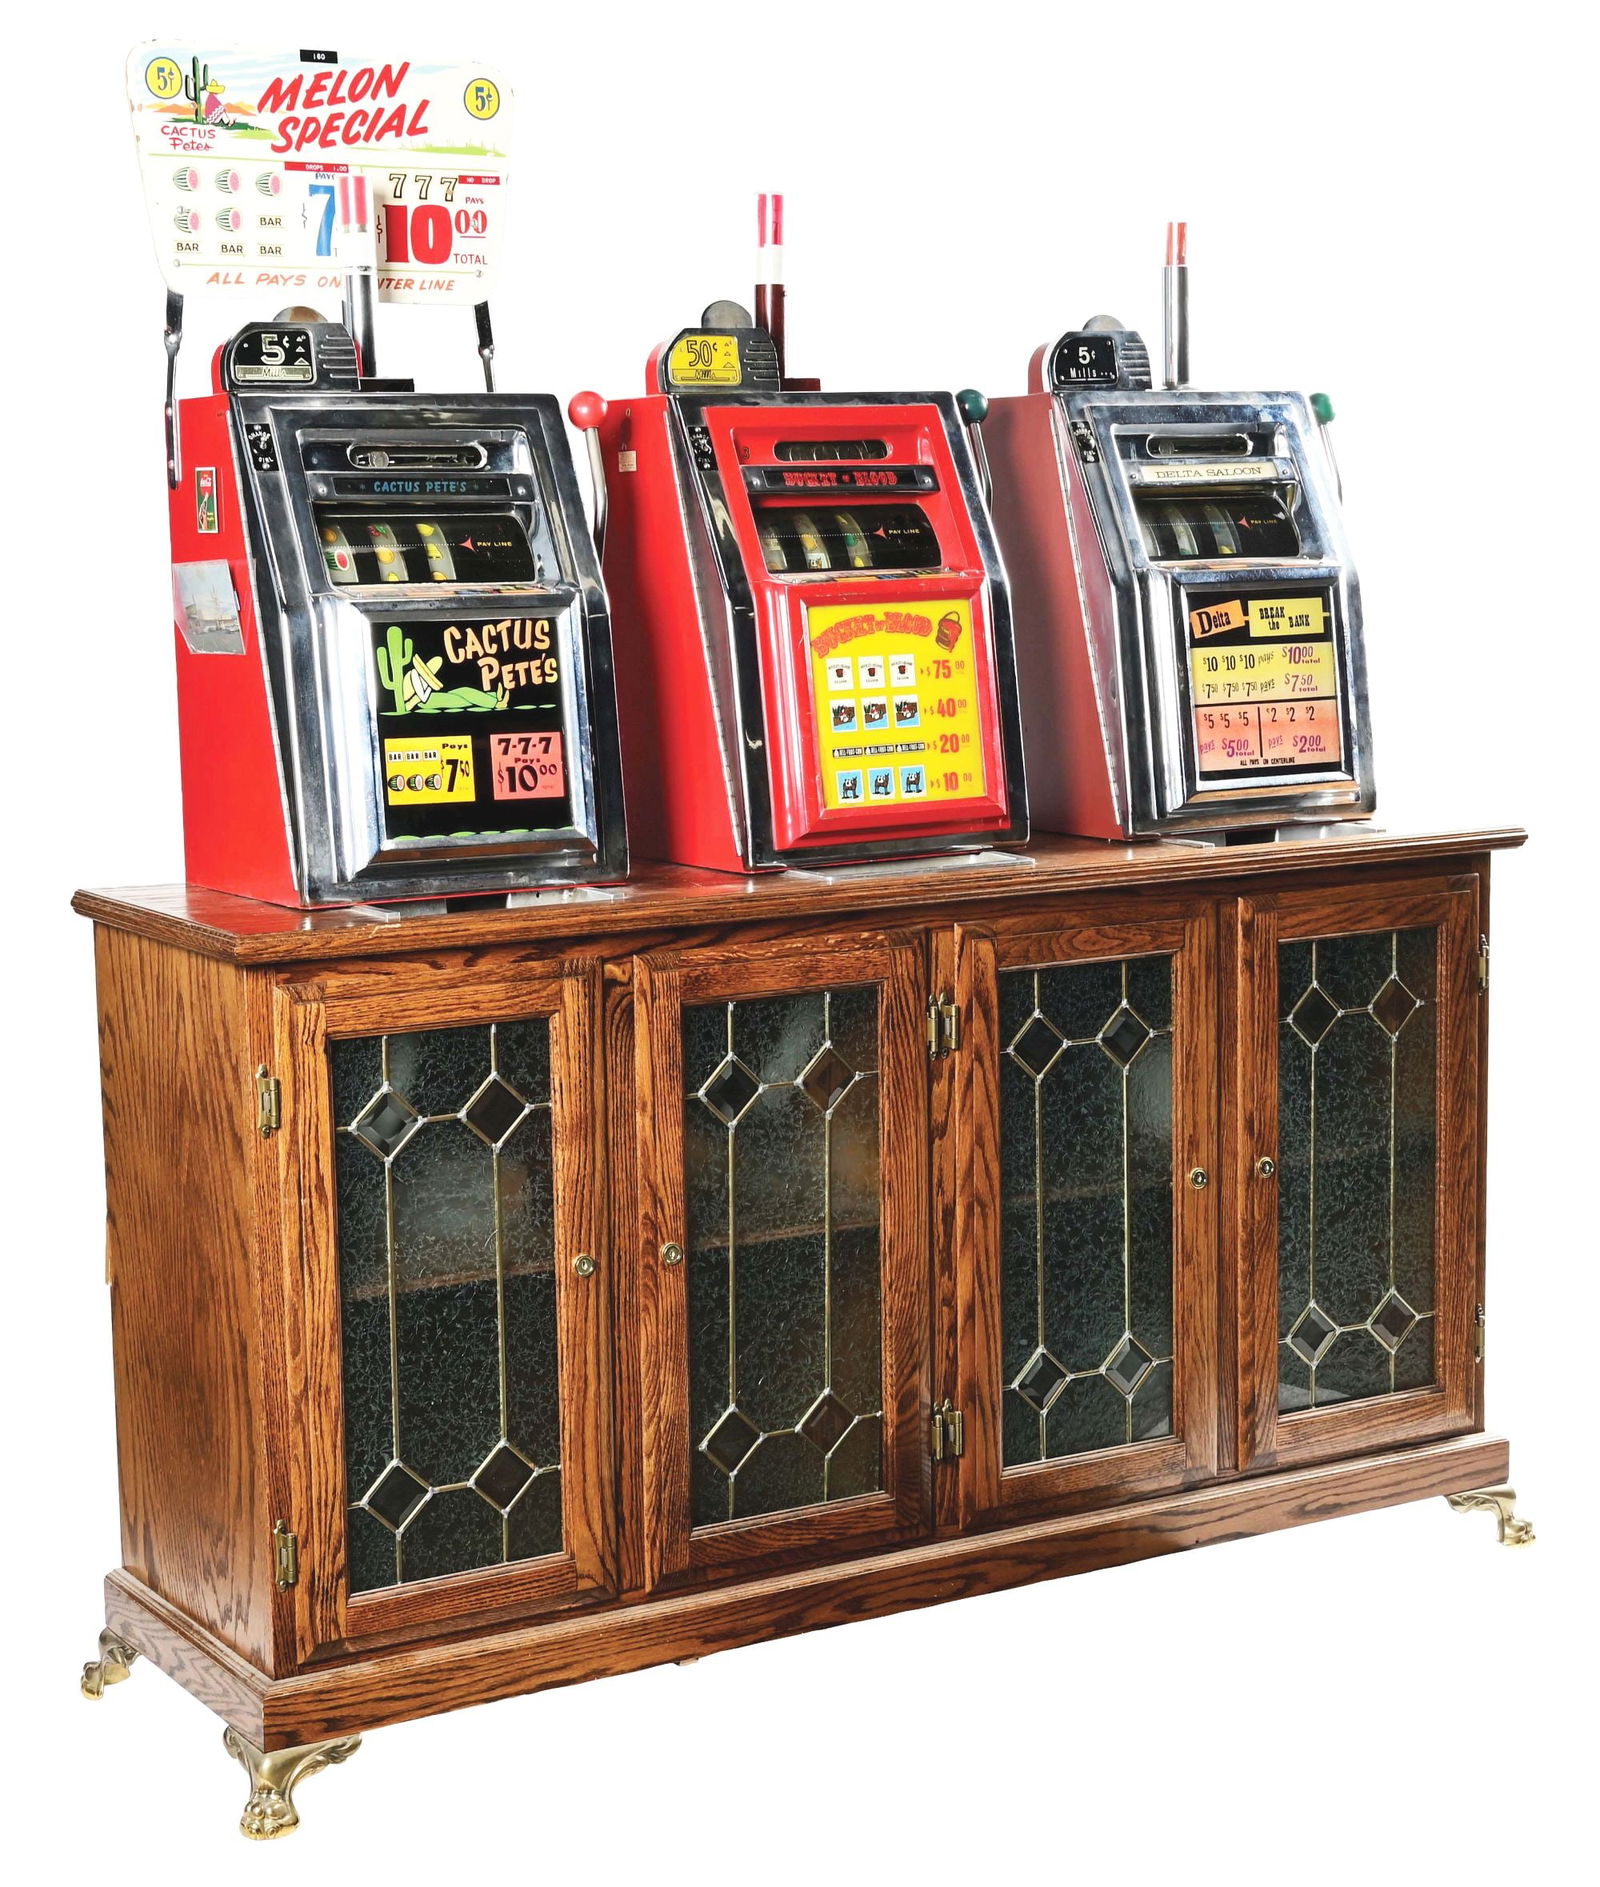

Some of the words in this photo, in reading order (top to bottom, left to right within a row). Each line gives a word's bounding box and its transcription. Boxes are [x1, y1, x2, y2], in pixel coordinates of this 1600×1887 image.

[257, 61, 410, 113] MELON
[160, 125, 216, 139] CACTUS
[271, 99, 430, 153] SPECIAL
[305, 164, 324, 172] DROPS
[389, 174, 407, 198] 7
[415, 175, 432, 200] 7
[440, 177, 458, 201] 7
[465, 196, 484, 205] PAYS
[259, 216, 282, 227] BAR
[176, 242, 200, 252] BAR
[221, 243, 244, 254] BAR
[259, 245, 282, 255] BAR
[453, 253, 488, 265] TOTAL
[206, 271, 246, 285] ALL
[256, 272, 307, 286] PAYS
[317, 275, 342, 288] ON
[419, 279, 455, 291] LINE
[260, 333, 290, 365] 5¢
[686, 340, 718, 368] 50¢
[1078, 346, 1096, 365] 5¢
[853, 471, 898, 487] BLOOD
[1156, 470, 1201, 479] DELTA
[1206, 466, 1263, 478] SALOON
[373, 481, 420, 492] CACTUS
[426, 481, 467, 492] PETE'S
[1259, 606, 1285, 620] BREAK
[883, 611, 933, 638] BLOOD
[1196, 611, 1231, 635] Delta
[1268, 620, 1280, 631] the
[1288, 614, 1310, 628] BANK
[443, 620, 551, 664] CACTUS
[477, 652, 559, 692] PETE'S
[1204, 713, 1215, 729] $5
[1220, 713, 1230, 728] $5
[1238, 711, 1249, 727] $5
[1286, 706, 1296, 722] $2
[1305, 705, 1315, 720] $2
[388, 753, 402, 761] BAR
[406, 752, 419, 760] BAR
[424, 751, 437, 759] BAR
[514, 757, 541, 765] Pays
